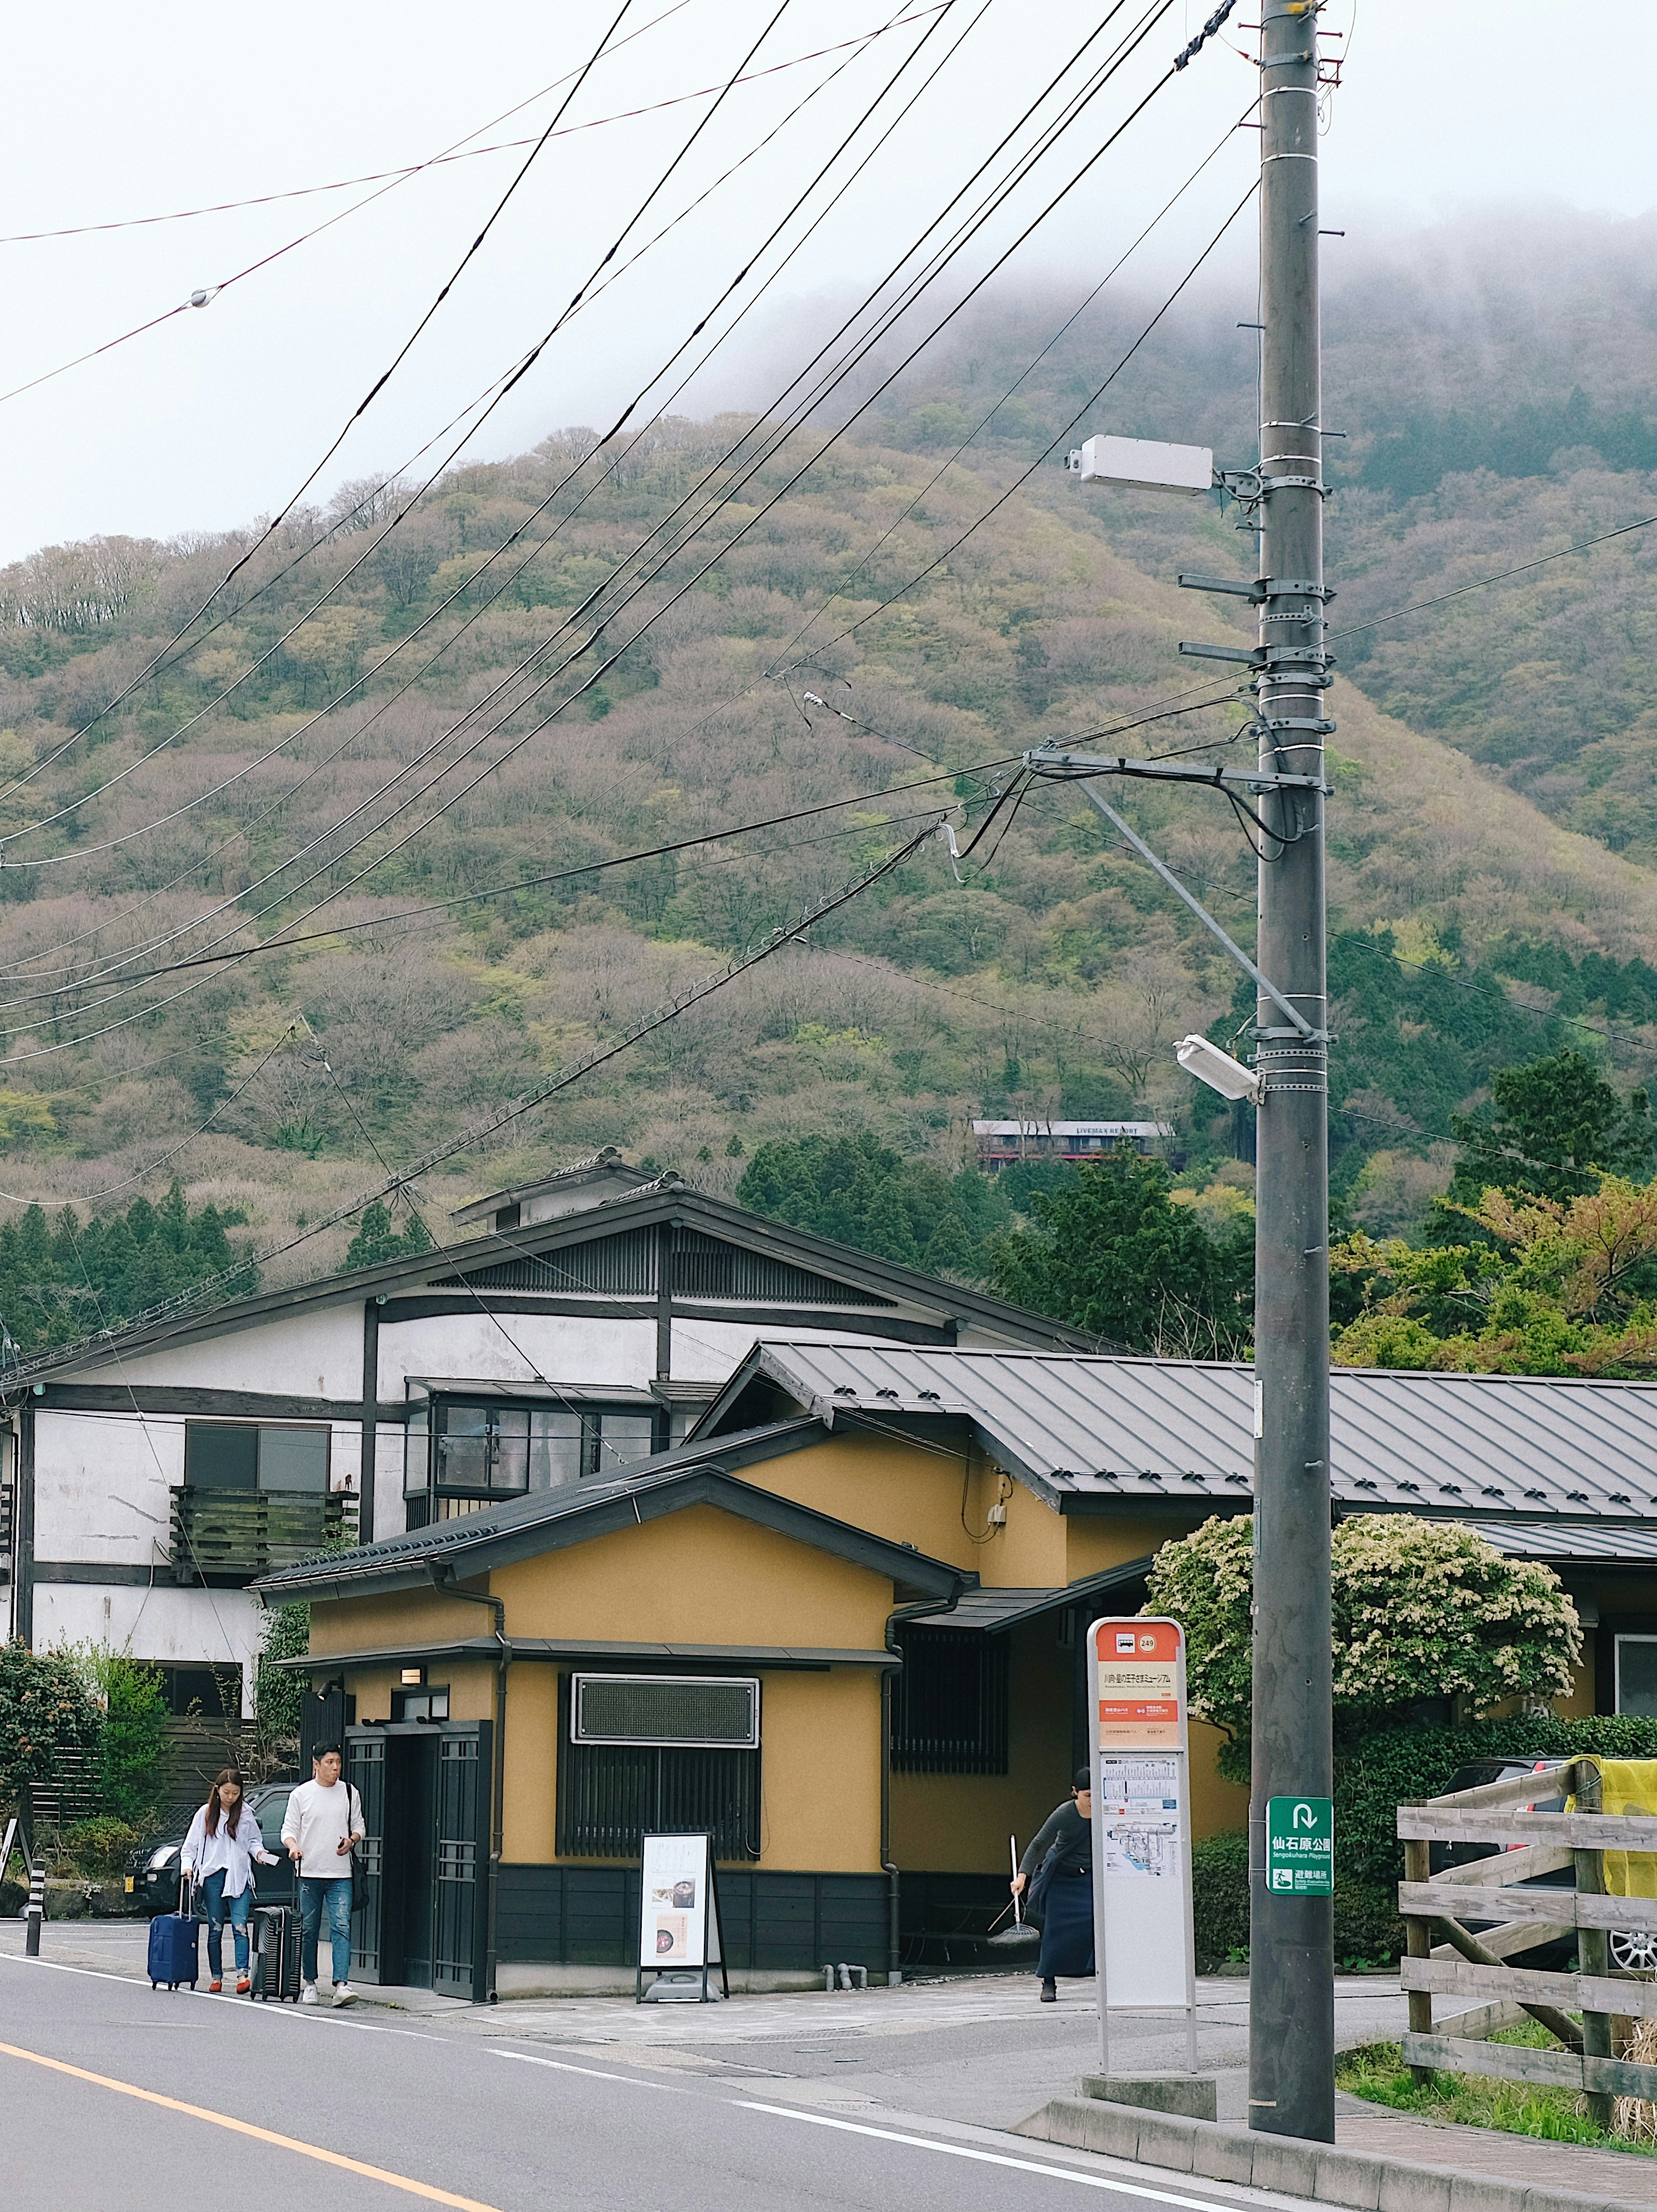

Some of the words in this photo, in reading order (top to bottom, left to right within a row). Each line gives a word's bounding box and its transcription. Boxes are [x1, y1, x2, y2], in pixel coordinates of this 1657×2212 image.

[1272, 1836, 1330, 1851] 仙石原公園
[1295, 1870, 1327, 1880] 避難場所
